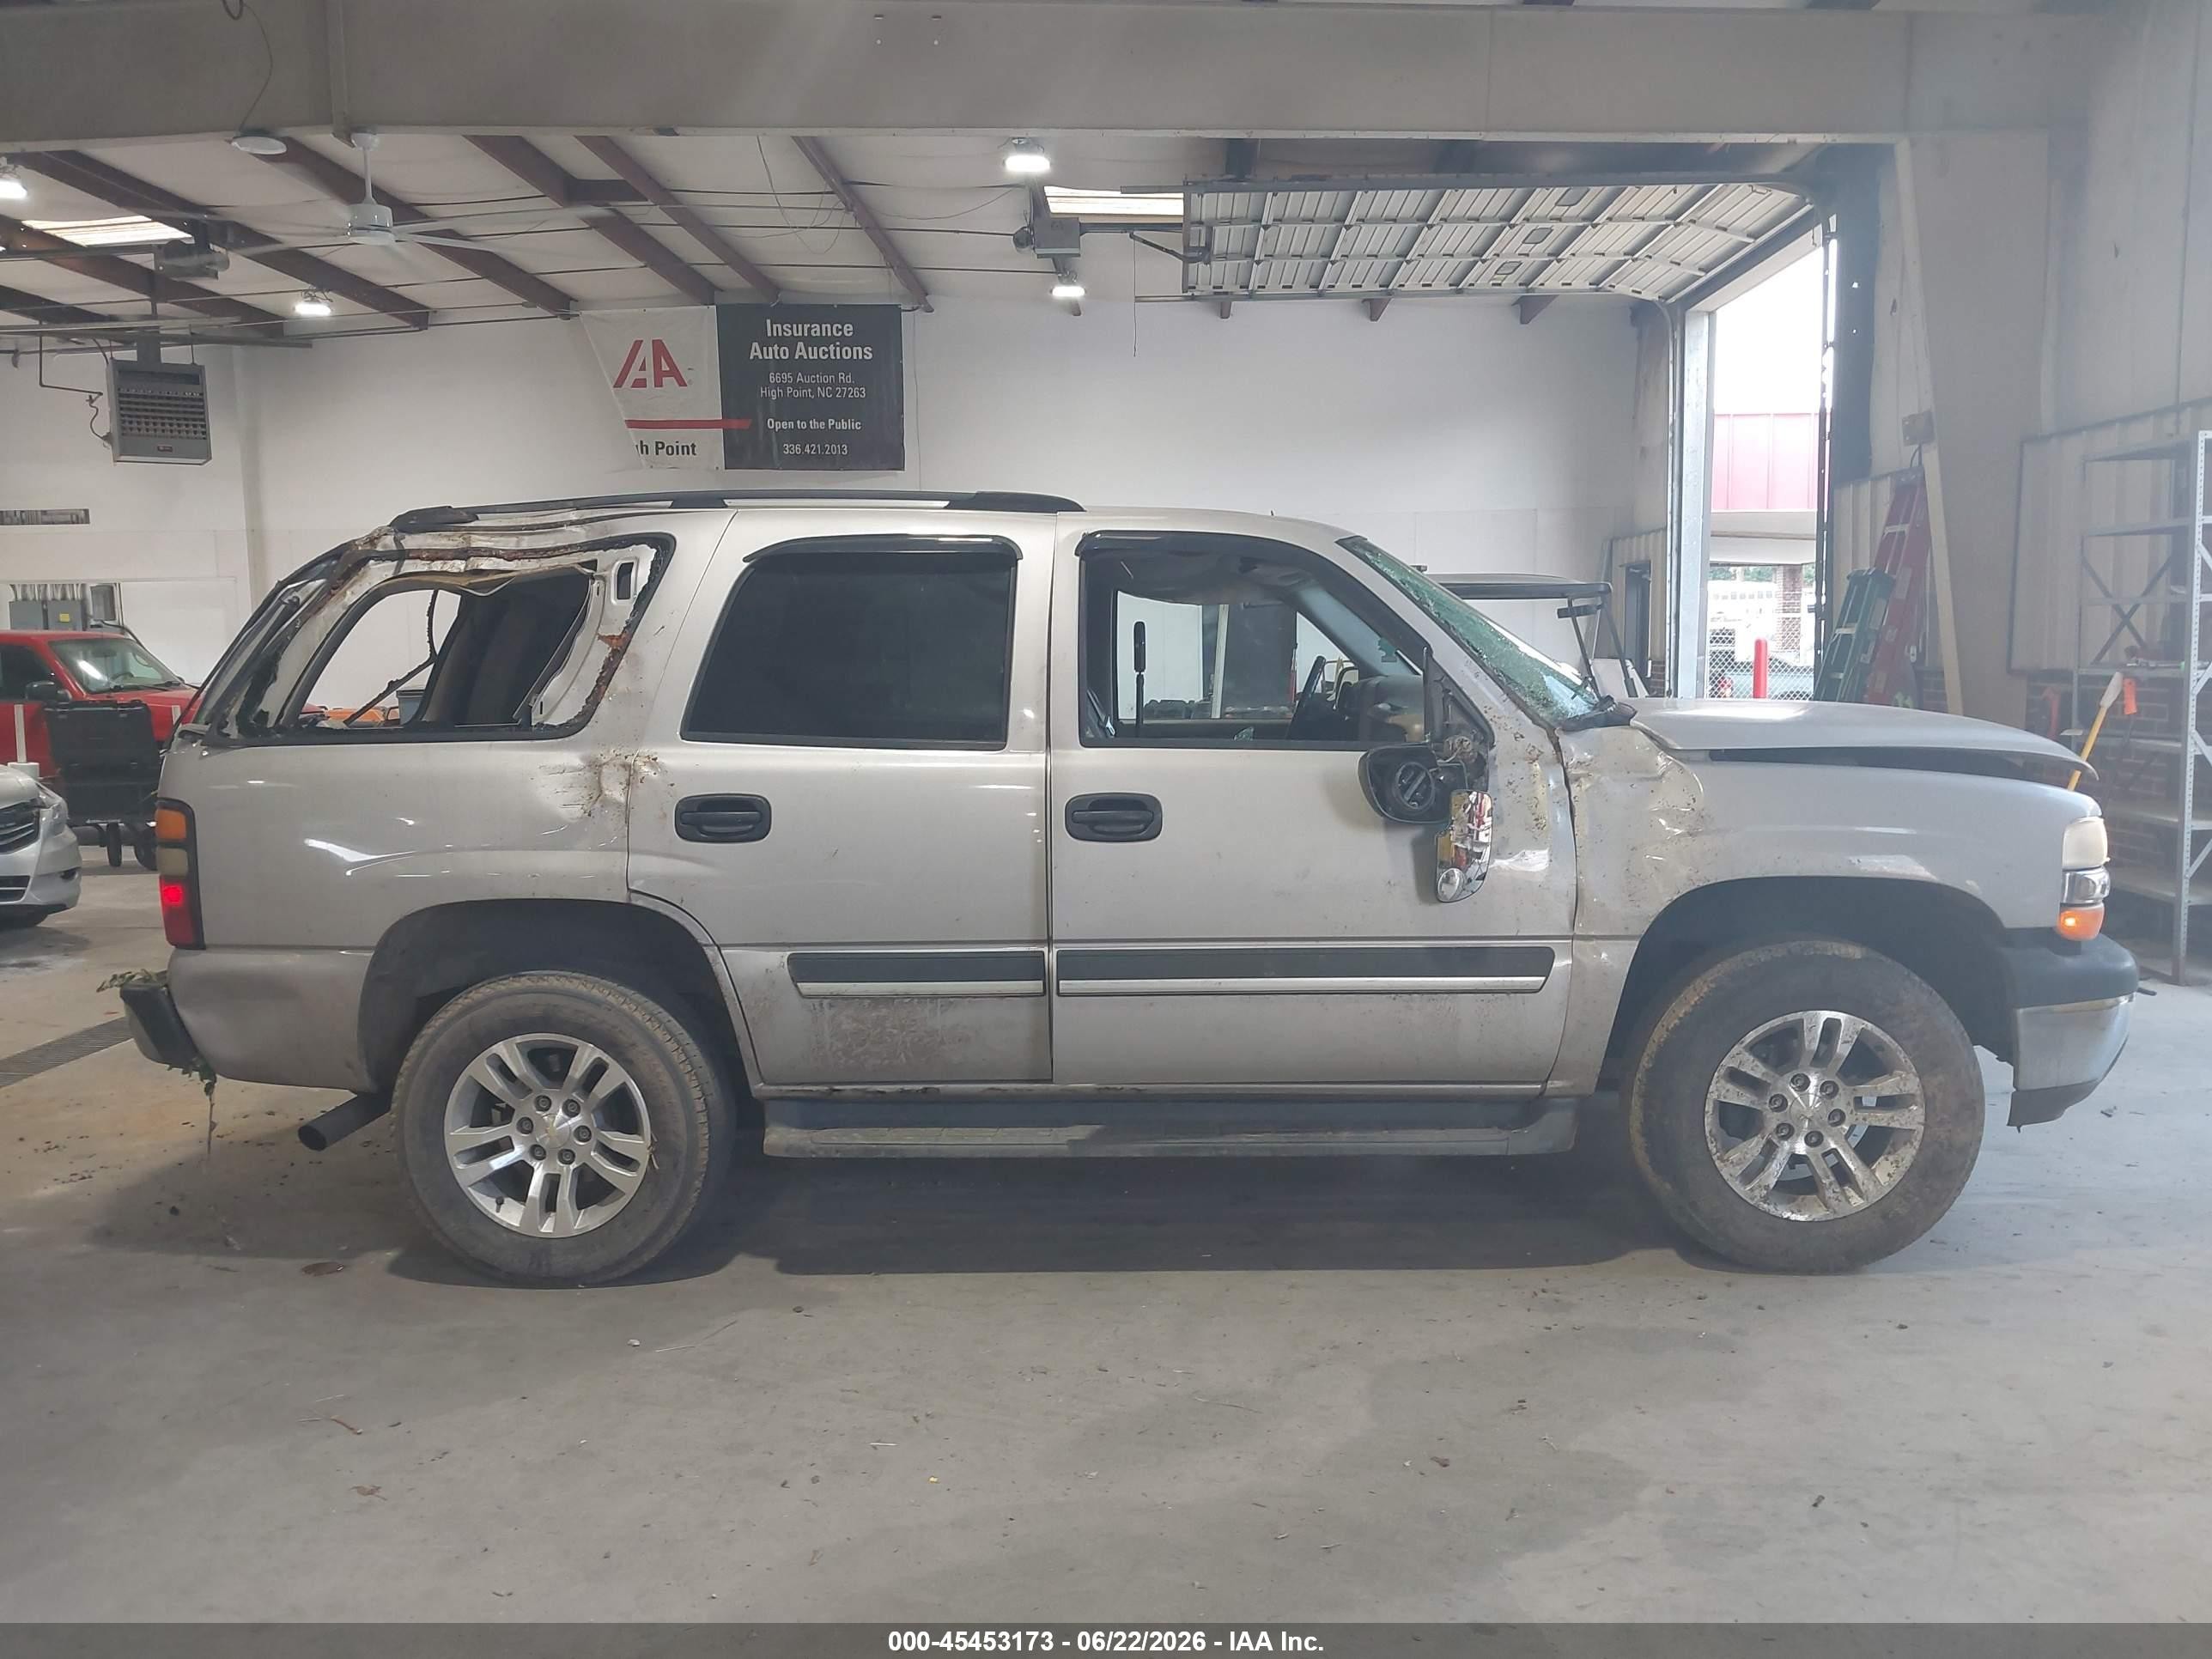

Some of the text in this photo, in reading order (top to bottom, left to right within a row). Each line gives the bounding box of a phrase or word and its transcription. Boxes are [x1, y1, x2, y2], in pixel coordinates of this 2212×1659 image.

[766, 319, 854, 337] Insurance
[750, 342, 873, 360] Auto Auctions
[769, 372, 855, 384] 6695 Auction Rd.
[760, 386, 866, 400] High Point, NC 27263
[767, 418, 862, 432] Open to the Public
[655, 441, 697, 456] Point
[783, 444, 848, 455] 336.421.2013
